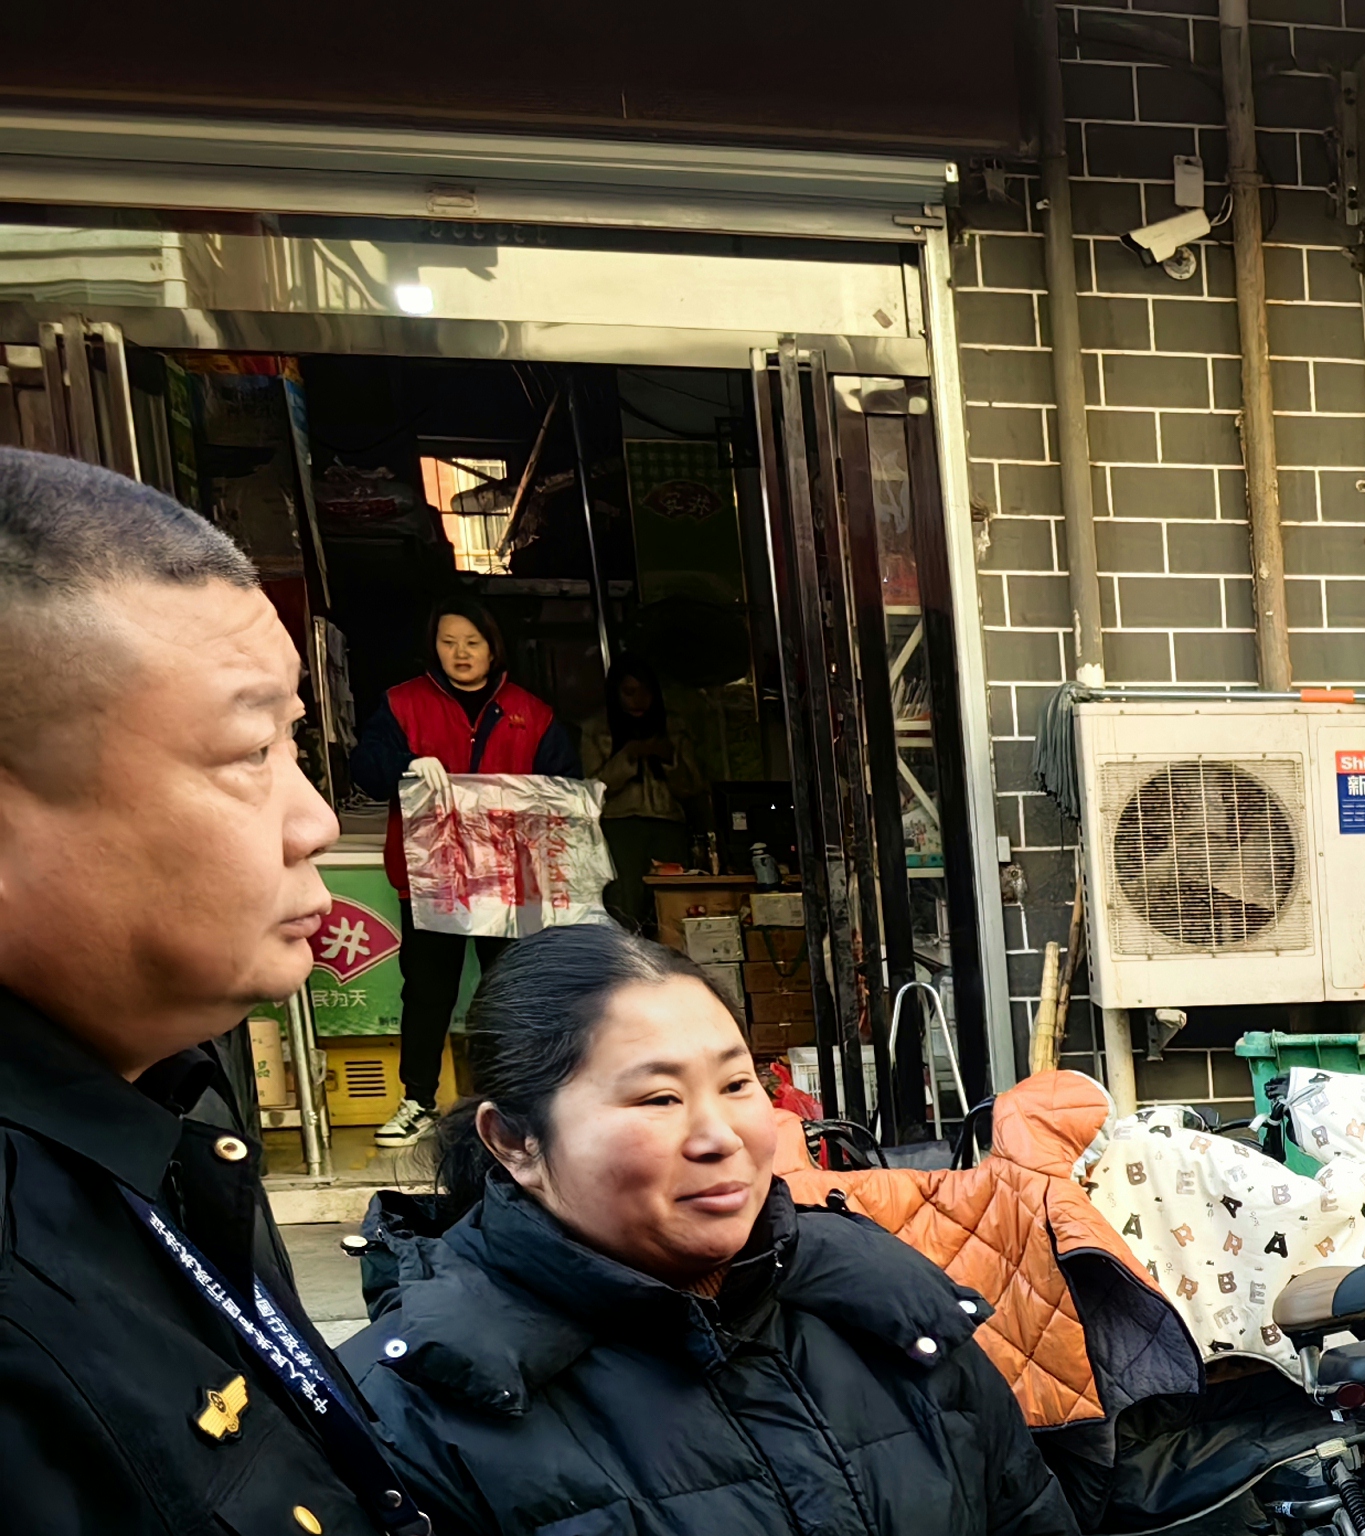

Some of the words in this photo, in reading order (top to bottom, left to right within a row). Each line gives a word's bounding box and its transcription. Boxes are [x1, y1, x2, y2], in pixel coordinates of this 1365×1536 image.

[1126, 1161, 1147, 1185] B
[1176, 1170, 1196, 1194] E
[1272, 1183, 1291, 1205] B
[1220, 1194, 1243, 1219] A
[1122, 1213, 1143, 1240] A
[1170, 1223, 1195, 1247] R
[1223, 1230, 1243, 1256] R
[1264, 1231, 1288, 1258] A
[1314, 1236, 1335, 1258] R
[1176, 1274, 1199, 1301] R
[1217, 1271, 1237, 1294] B
[150, 1211, 328, 1414] 中华人民共和国行政执法证
[1260, 1323, 1282, 1346] B
